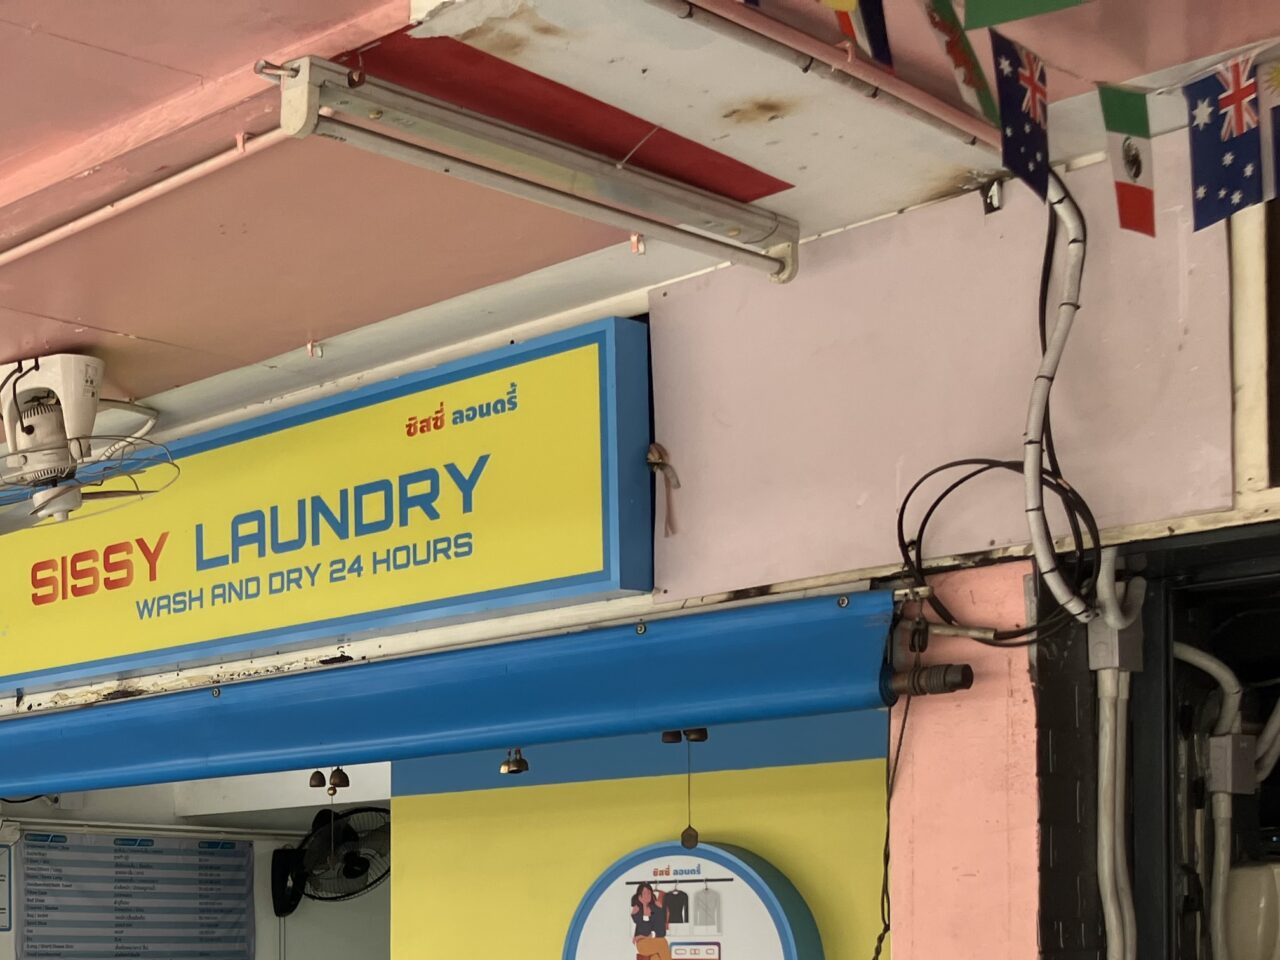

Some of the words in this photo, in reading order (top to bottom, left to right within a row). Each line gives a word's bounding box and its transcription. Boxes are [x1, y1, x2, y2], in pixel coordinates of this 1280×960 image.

[30, 531, 170, 606] SISSY
[195, 453, 491, 572] LAUNDRY
[136, 587, 204, 620] WASH
[211, 576, 261, 606] AND
[268, 563, 321, 595] DRY
[329, 555, 364, 583] 24
[372, 532, 473, 575] HOURS
